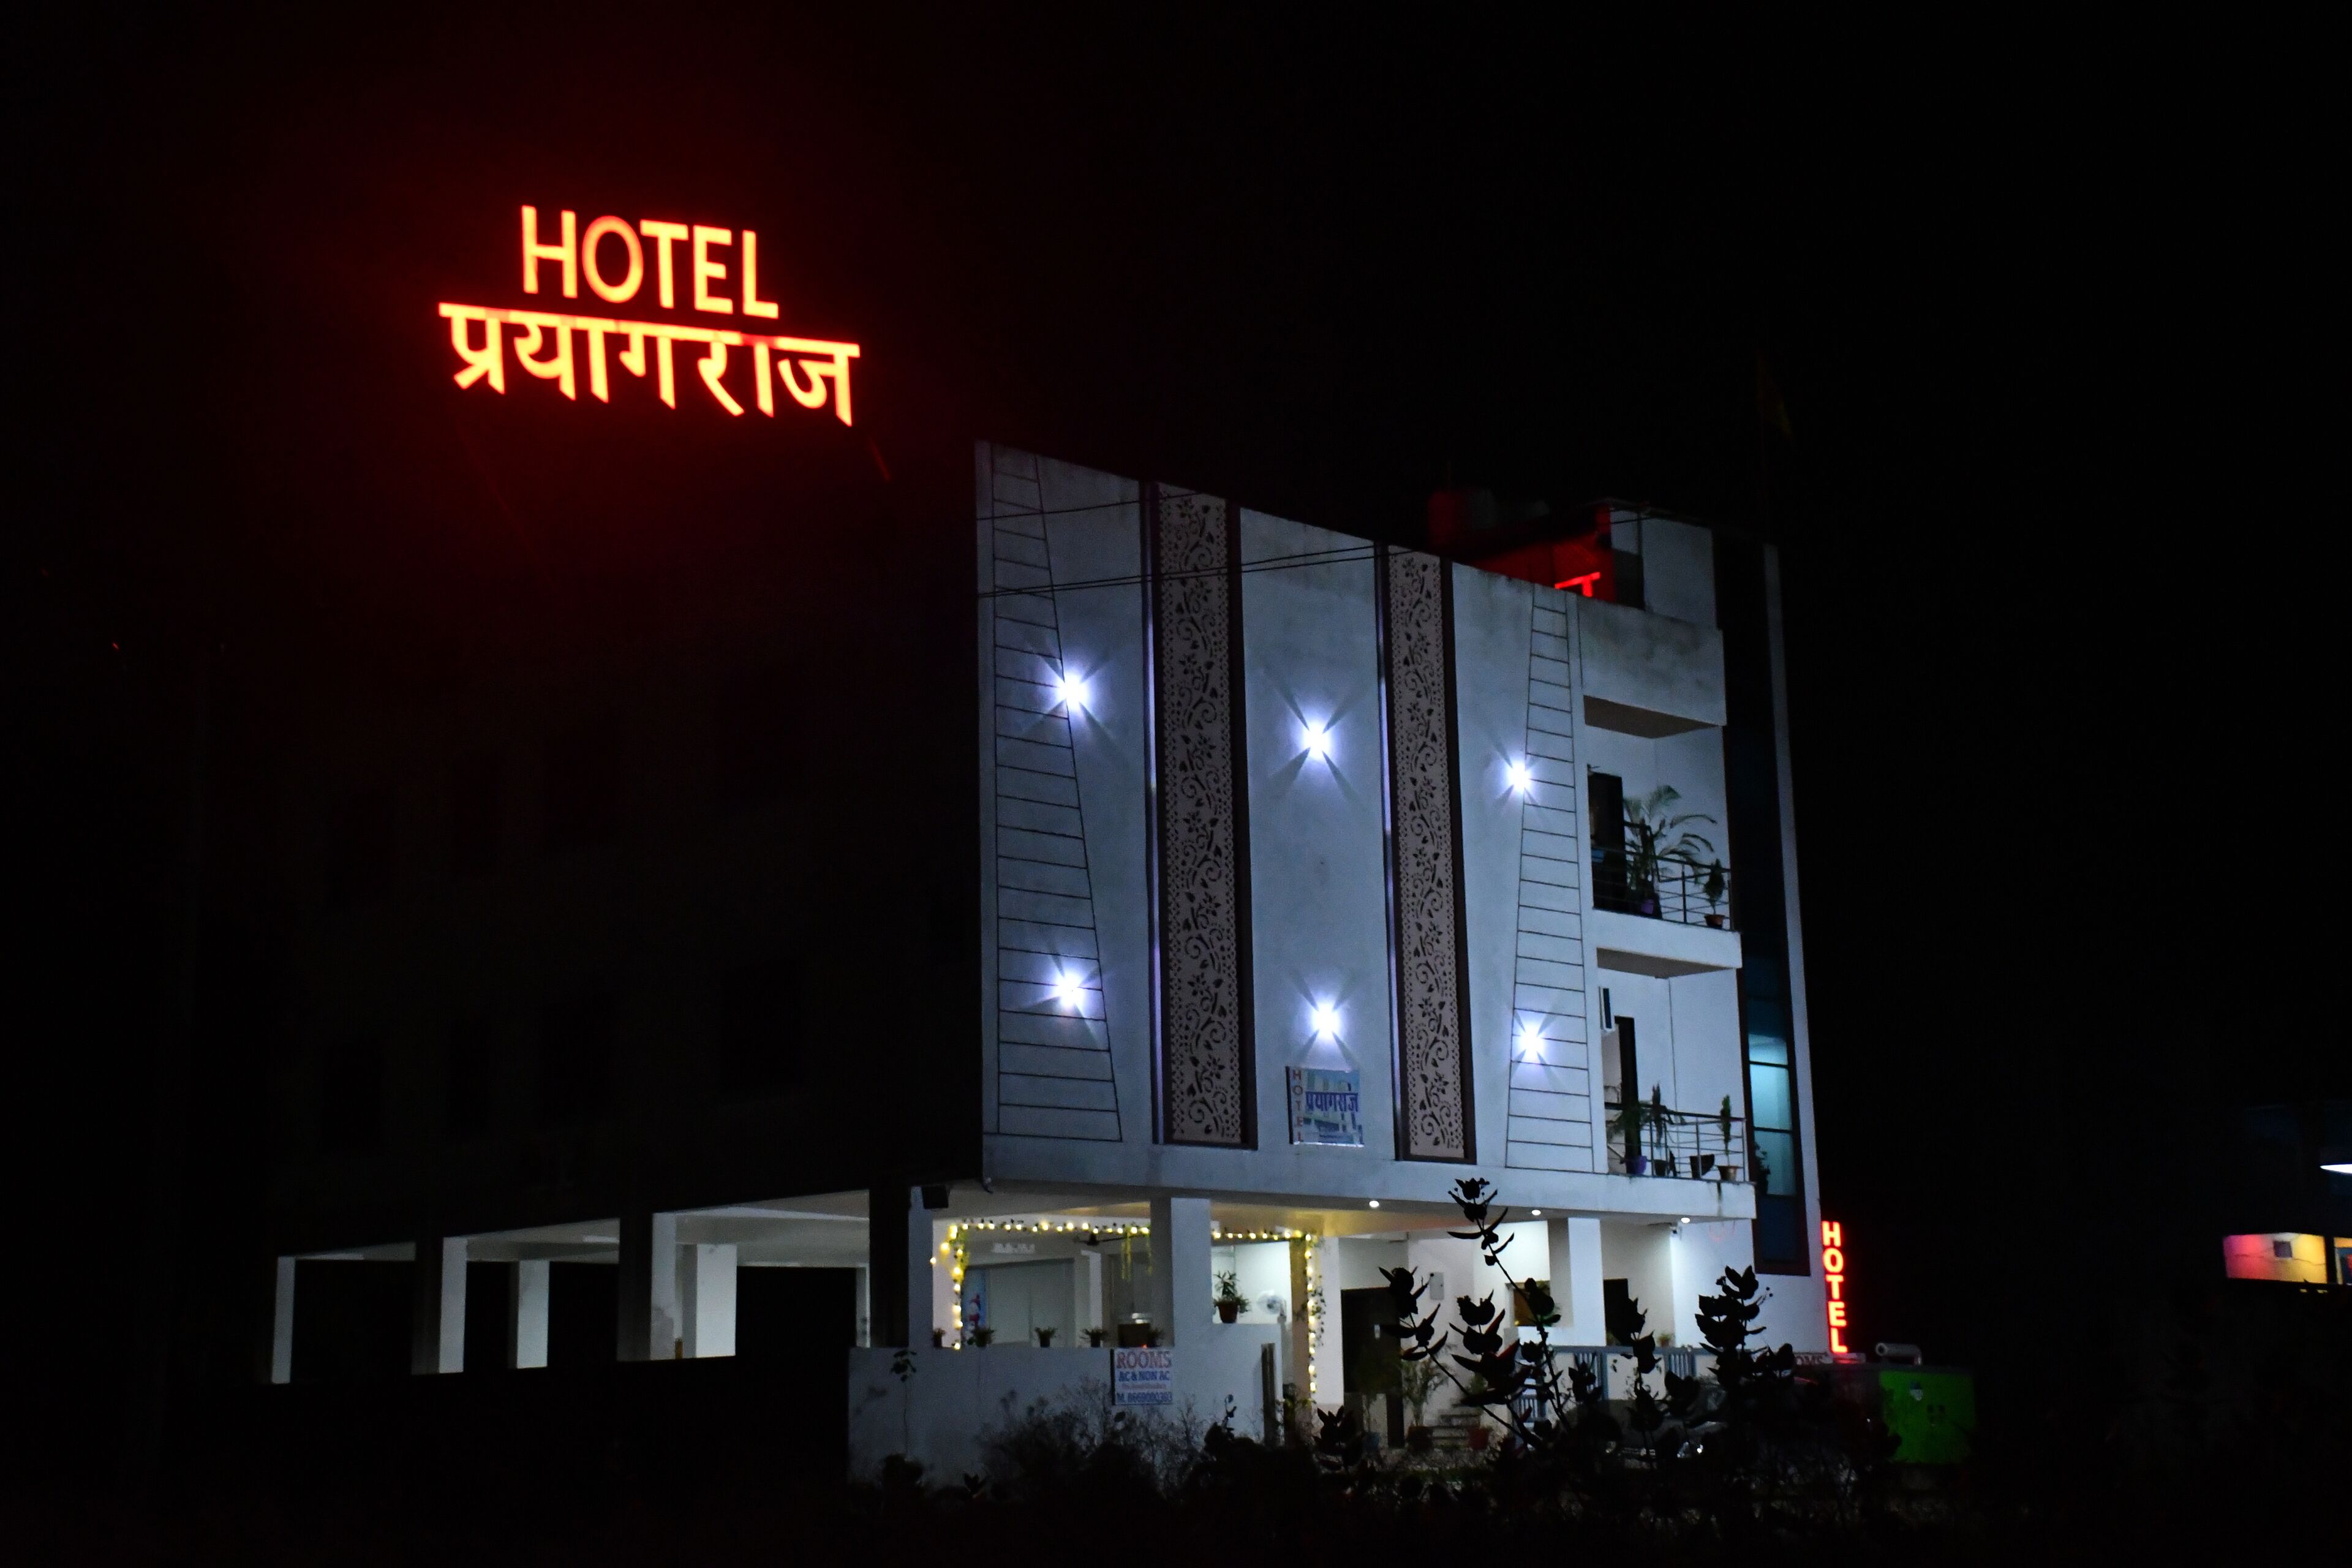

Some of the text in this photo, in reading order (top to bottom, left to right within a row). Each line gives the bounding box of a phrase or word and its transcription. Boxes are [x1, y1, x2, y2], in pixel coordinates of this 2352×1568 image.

[521, 205, 779, 320] HOTEL
[437, 302, 861, 426] प्रयागराज
[1822, 1221, 1847, 1354] HOTEL
[1117, 1351, 1172, 1369] ROOMS
